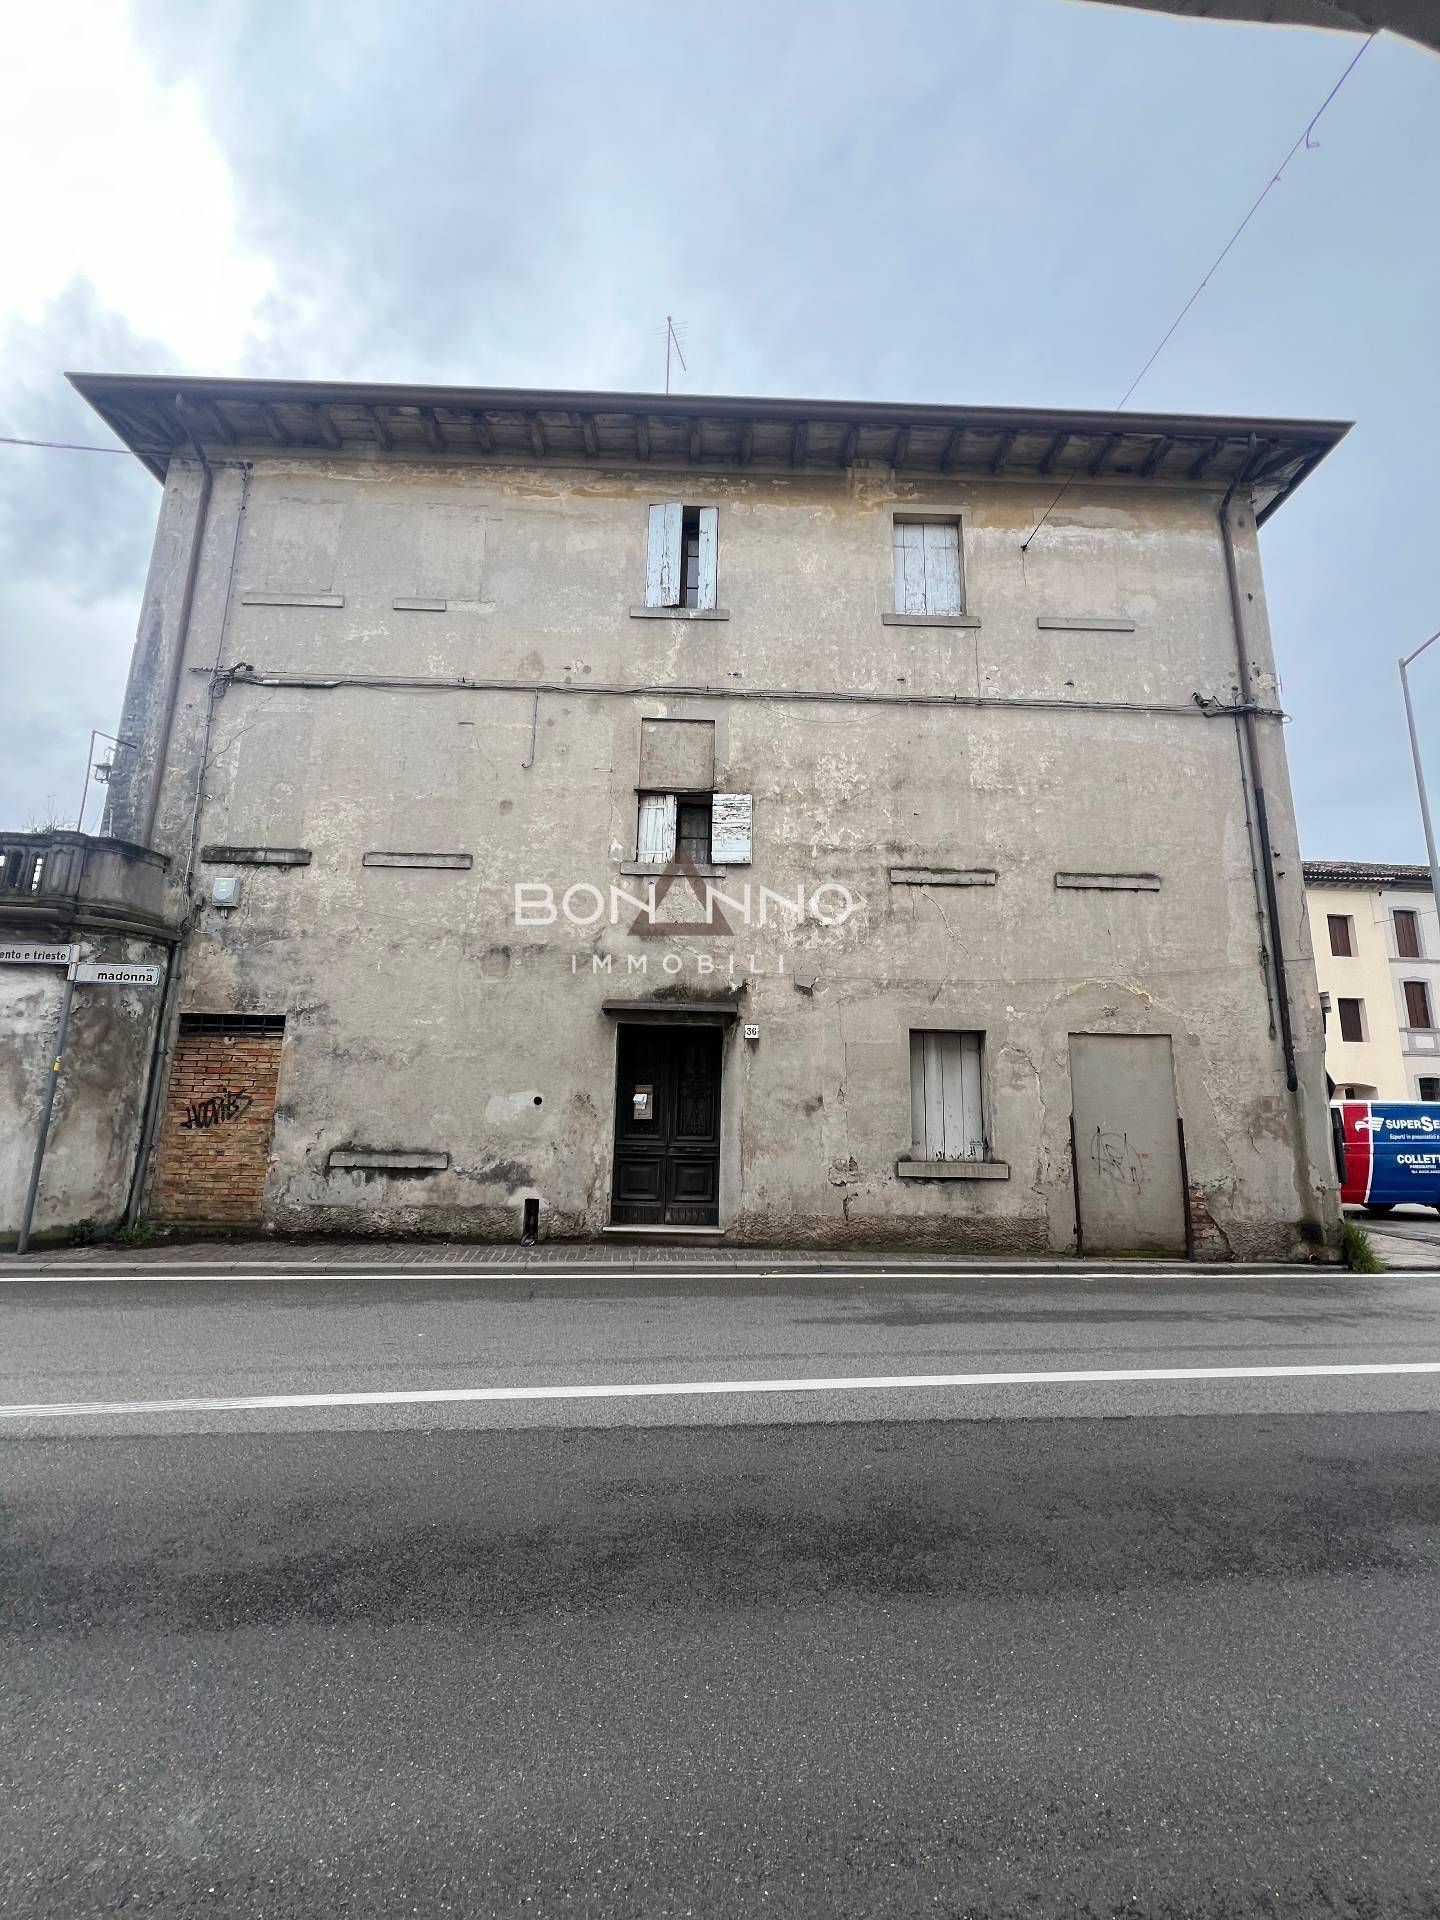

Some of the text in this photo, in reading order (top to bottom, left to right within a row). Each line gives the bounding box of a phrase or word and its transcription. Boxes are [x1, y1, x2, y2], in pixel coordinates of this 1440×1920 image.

[24, 951, 30, 960] e
[33, 949, 67, 960] trieste
[97, 971, 153, 982] madonna
[746, 1027, 757, 1036] 36
